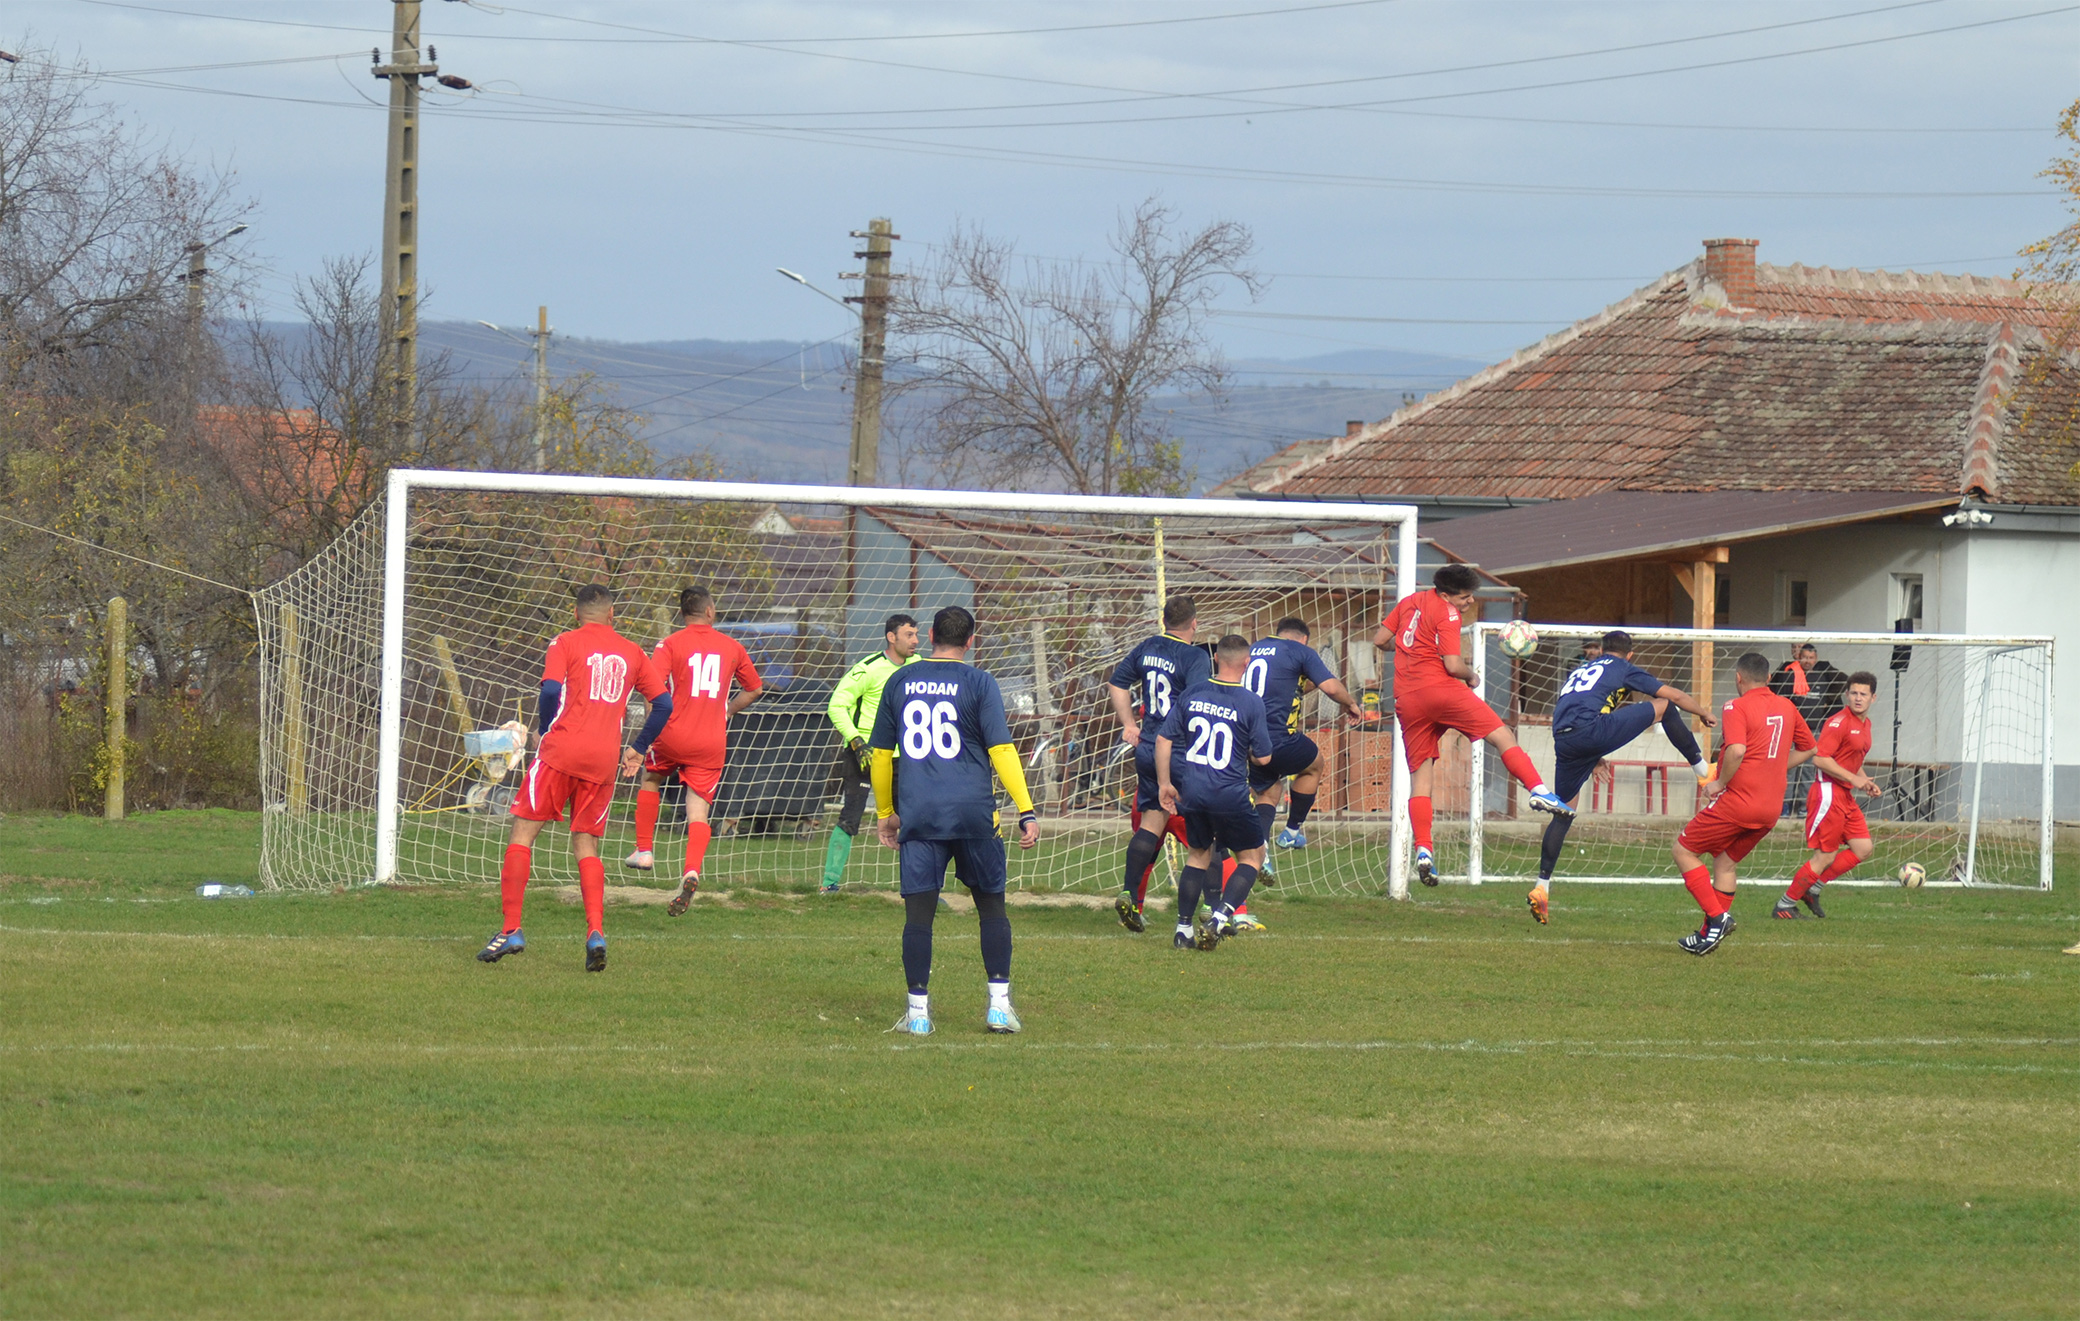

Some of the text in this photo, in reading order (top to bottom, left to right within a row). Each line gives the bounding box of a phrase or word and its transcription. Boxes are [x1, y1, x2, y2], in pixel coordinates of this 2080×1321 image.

[1250, 647, 1277, 656] LUCA
[586, 652, 628, 703] 18
[688, 652, 721, 699] 14
[904, 681, 959, 697] HODAN
[1240, 658, 1268, 698] 0
[1560, 664, 1604, 696] 29
[903, 699, 961, 760] 86
[1188, 700, 1238, 722] ZBERCEA
[1185, 715, 1233, 770] 20
[1766, 715, 1784, 759] 7
